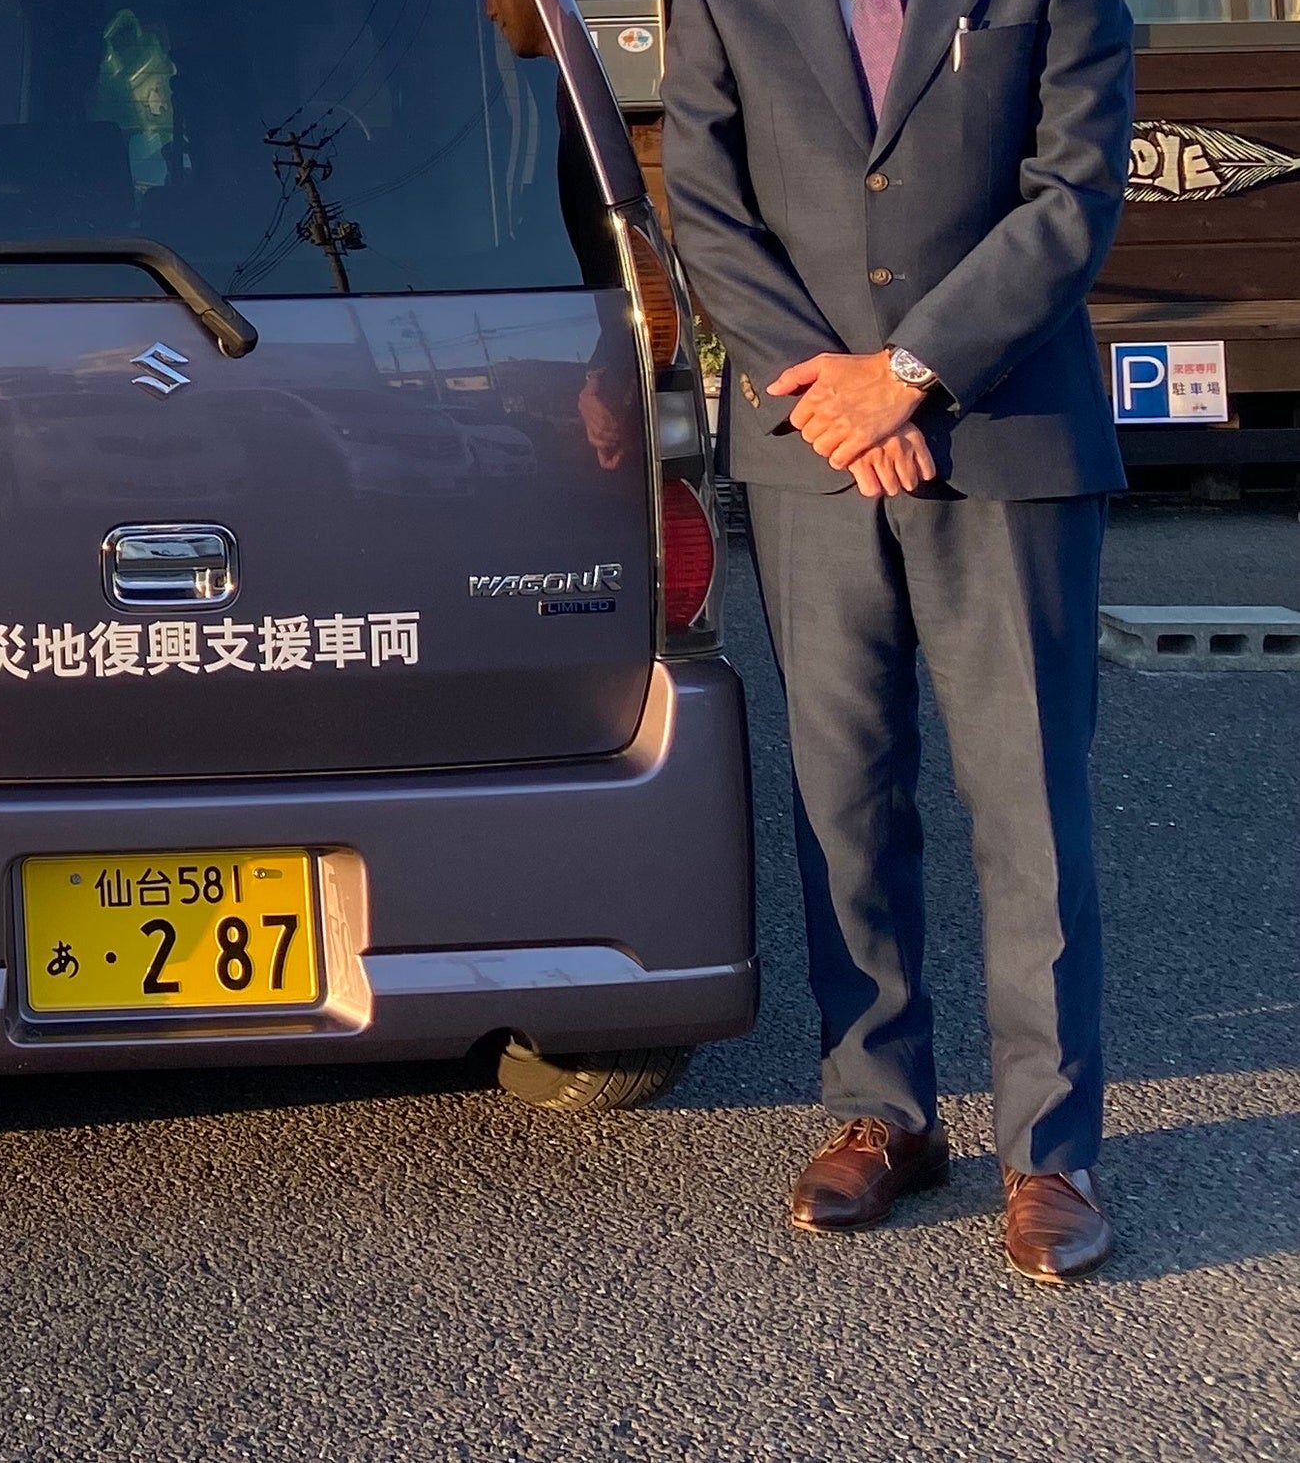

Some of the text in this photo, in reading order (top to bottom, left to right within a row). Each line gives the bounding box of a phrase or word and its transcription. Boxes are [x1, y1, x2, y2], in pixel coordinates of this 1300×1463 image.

[1122, 355, 1166, 411] P
[1172, 382, 1220, 396] 駐車場
[548, 601, 609, 613] LIMITED
